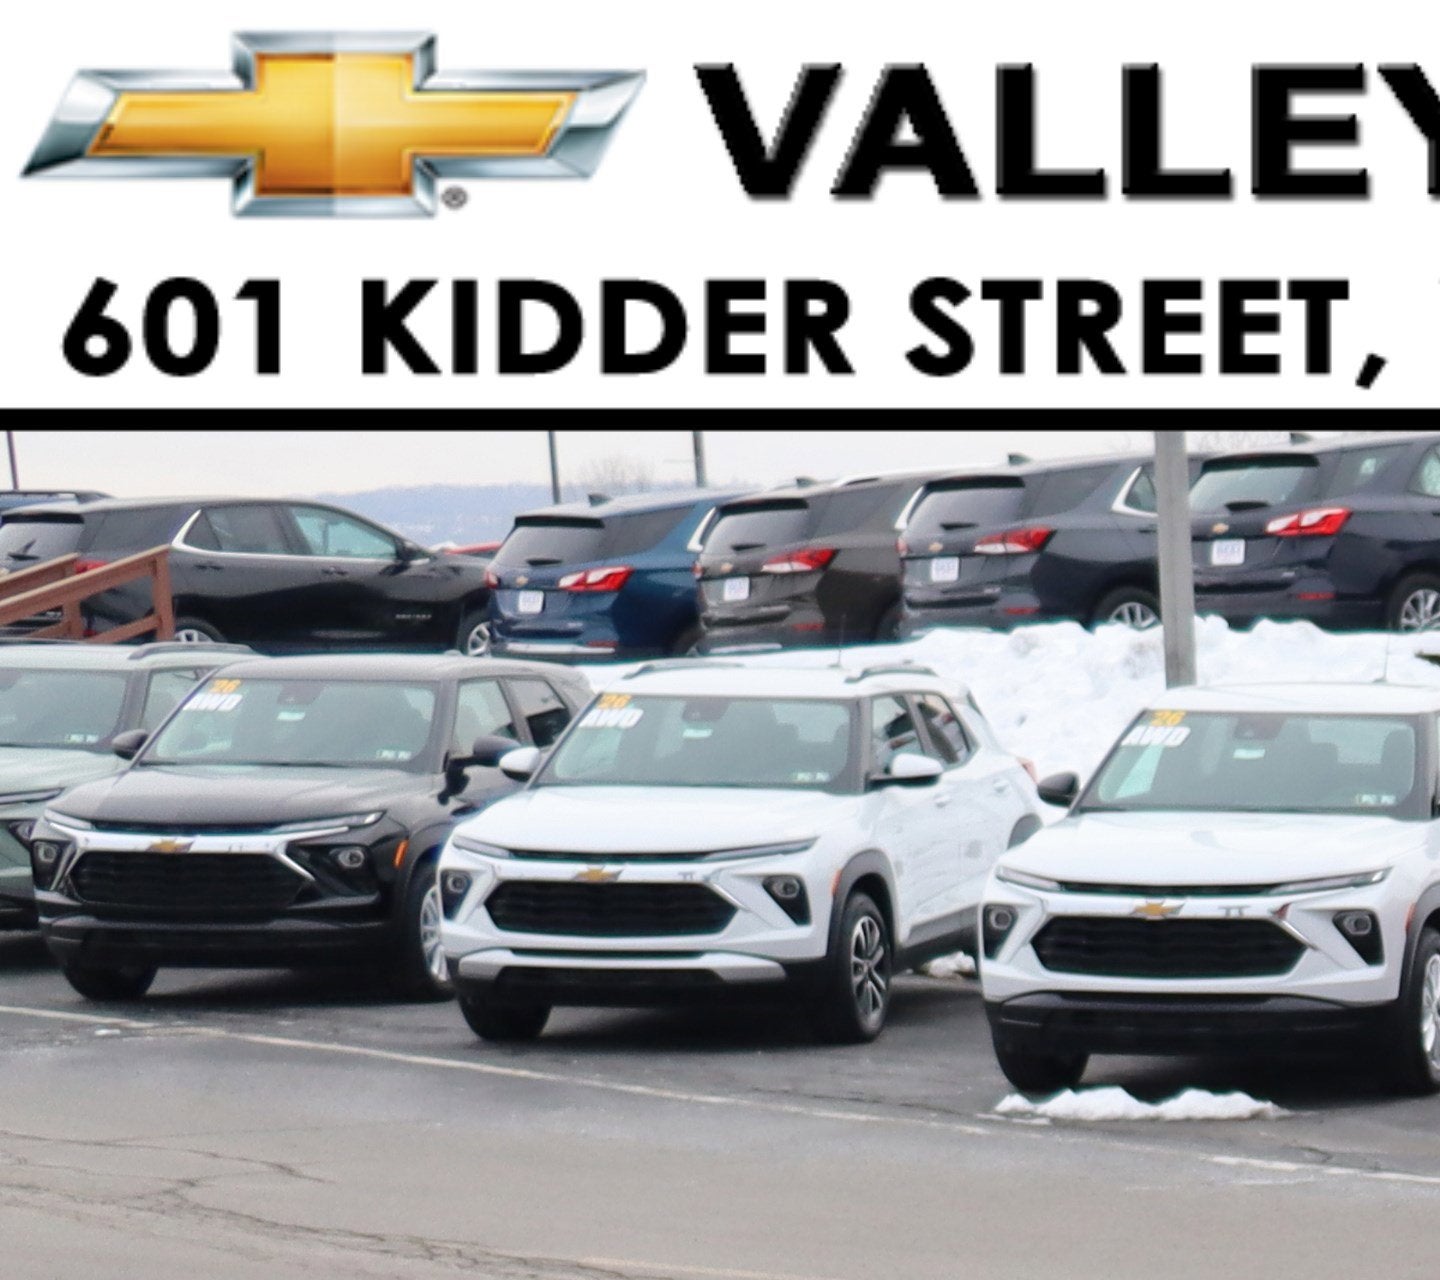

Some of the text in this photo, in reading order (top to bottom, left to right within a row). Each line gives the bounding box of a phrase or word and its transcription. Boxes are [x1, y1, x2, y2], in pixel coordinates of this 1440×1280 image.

[182, 693, 243, 711] AWD
[579, 708, 644, 729] AWD
[1120, 725, 1191, 747] AWD
